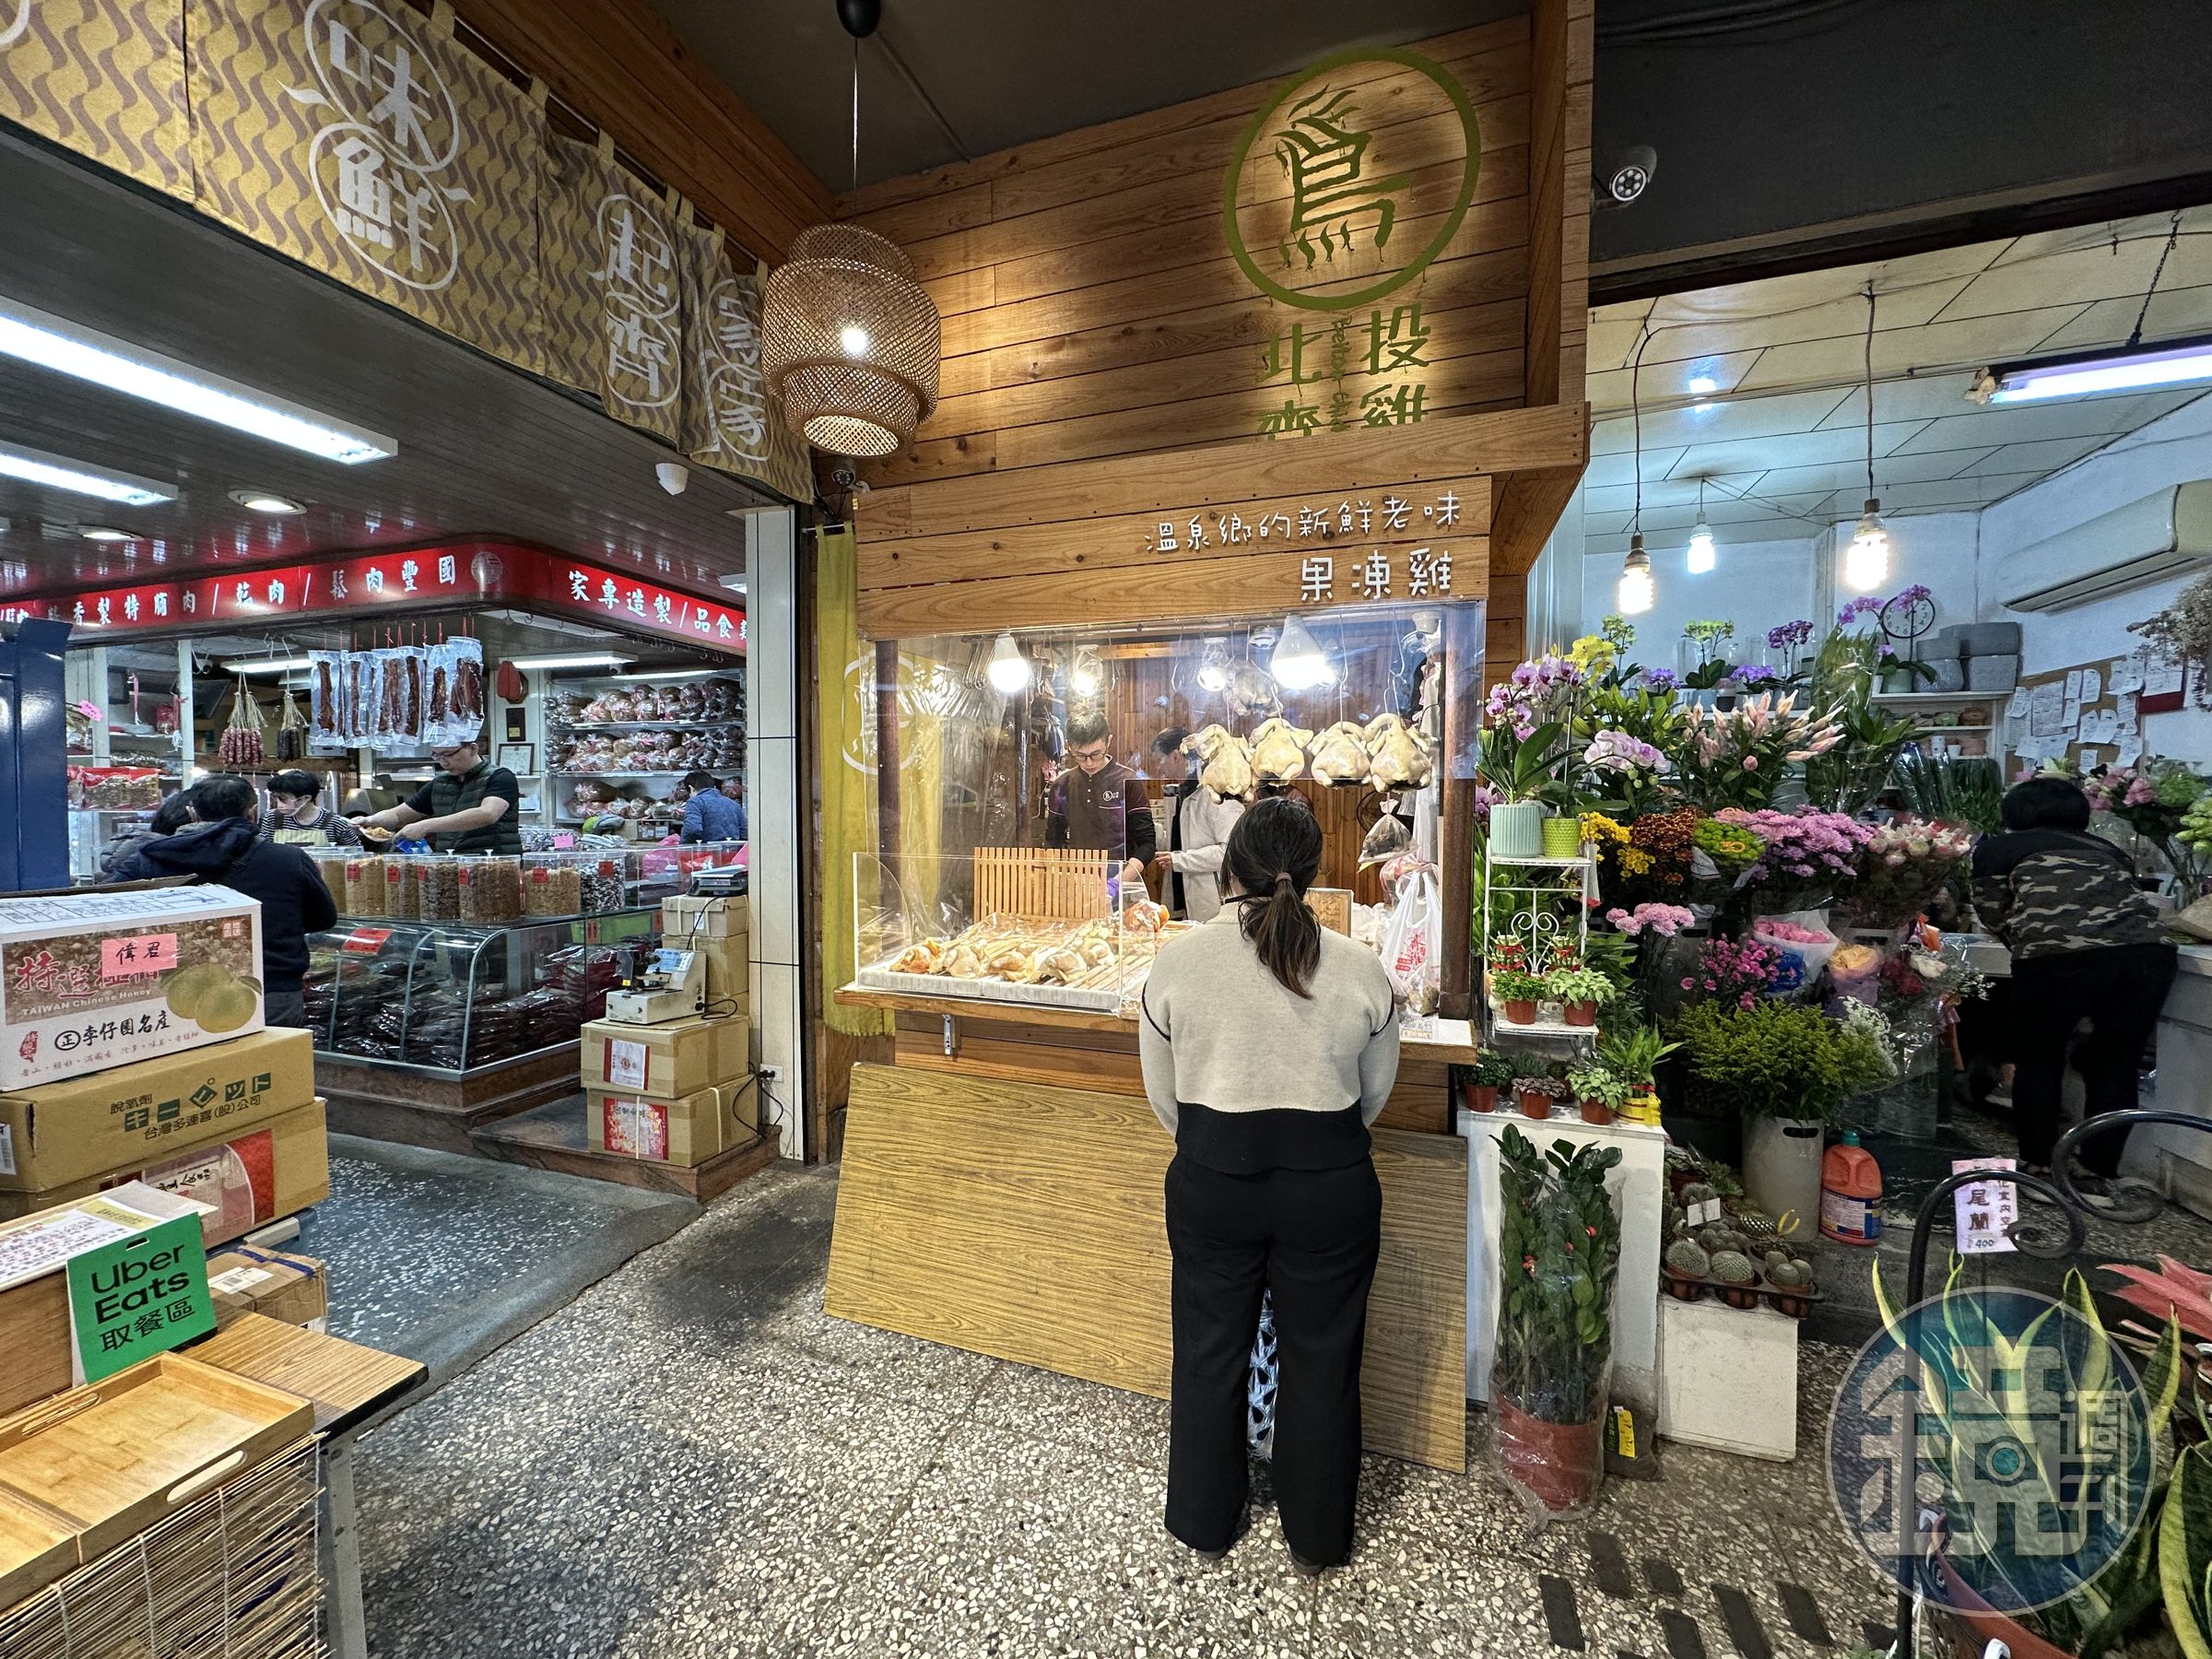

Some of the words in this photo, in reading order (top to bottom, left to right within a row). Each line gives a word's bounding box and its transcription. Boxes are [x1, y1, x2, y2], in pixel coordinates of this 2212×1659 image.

[1300, 547, 1453, 602] 果凍雞
[115, 941, 161, 966] 偉君
[22, 1002, 70, 1017] TAIWAN
[73, 994, 117, 1007] Chinese
[119, 988, 152, 1001] Honey
[91, 1243, 185, 1294] Uber
[1975, 1239, 1994, 1249] 400
[94, 1271, 191, 1324] Eats
[99, 1295, 196, 1353] 取餐區
